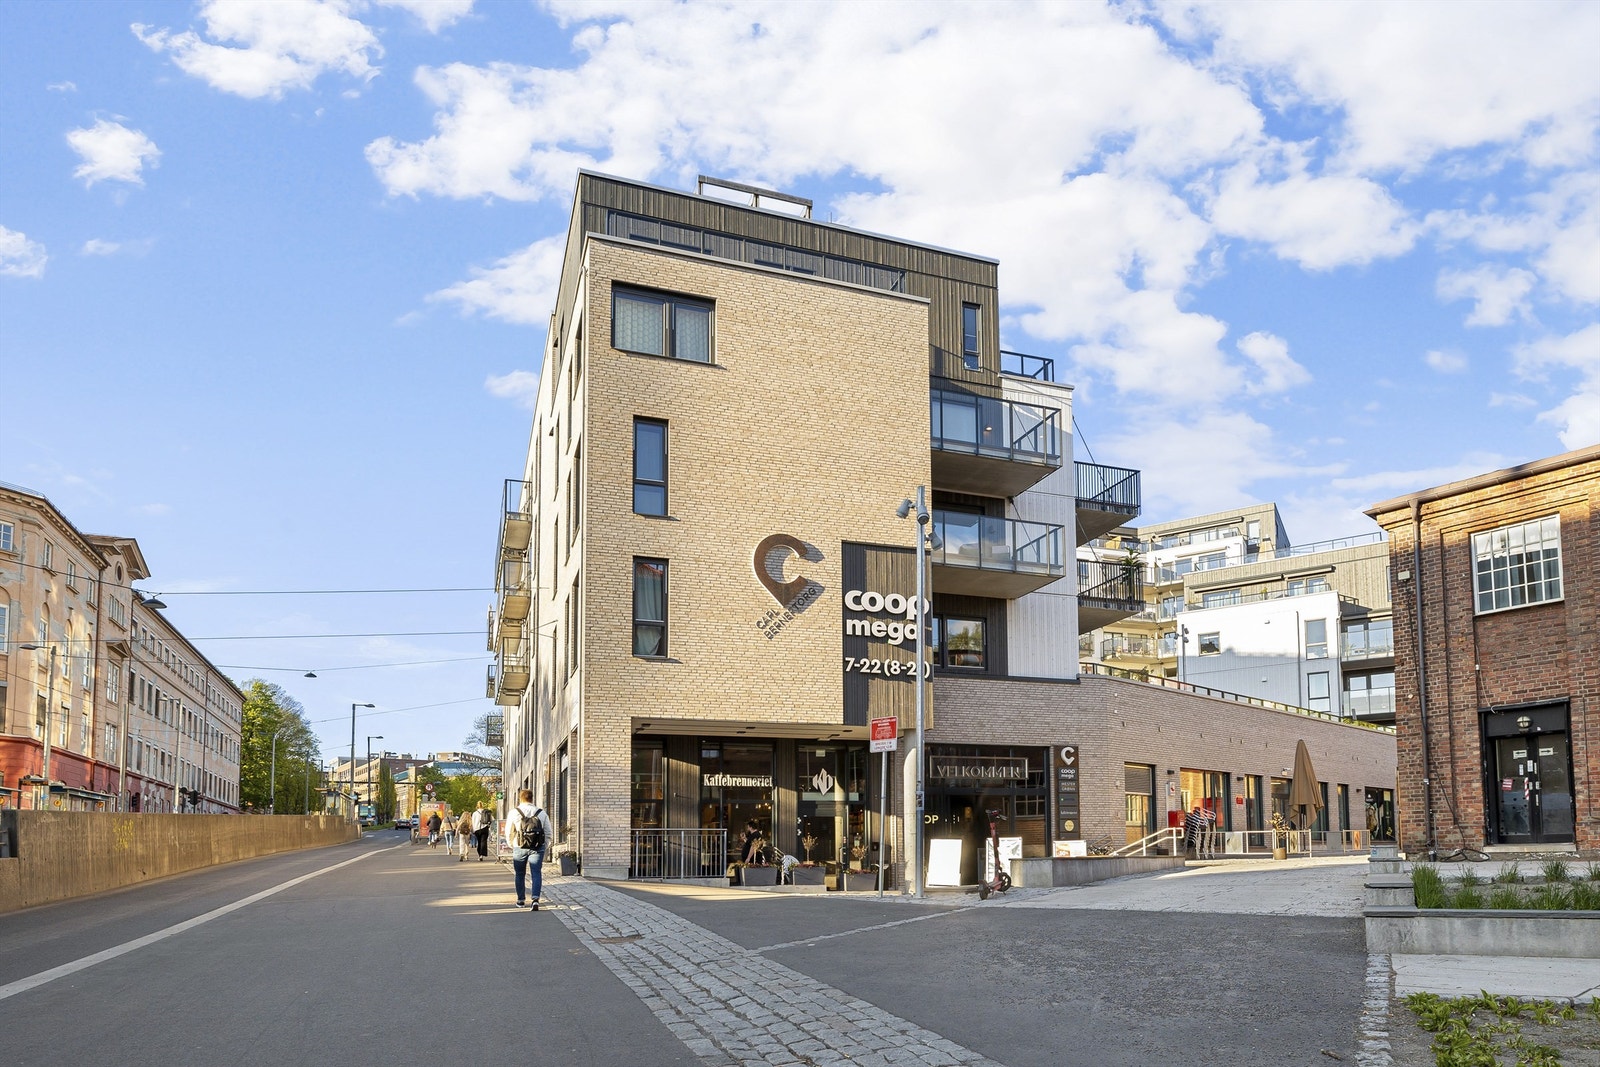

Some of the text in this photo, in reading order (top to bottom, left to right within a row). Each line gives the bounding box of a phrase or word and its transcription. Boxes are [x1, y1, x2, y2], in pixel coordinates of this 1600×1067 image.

[844, 590, 930, 620] coop
[755, 609, 780, 630] CARL
[845, 657, 931, 679] 7-22 (8-2)
[703, 772, 773, 787] Kaffebrenneriet
